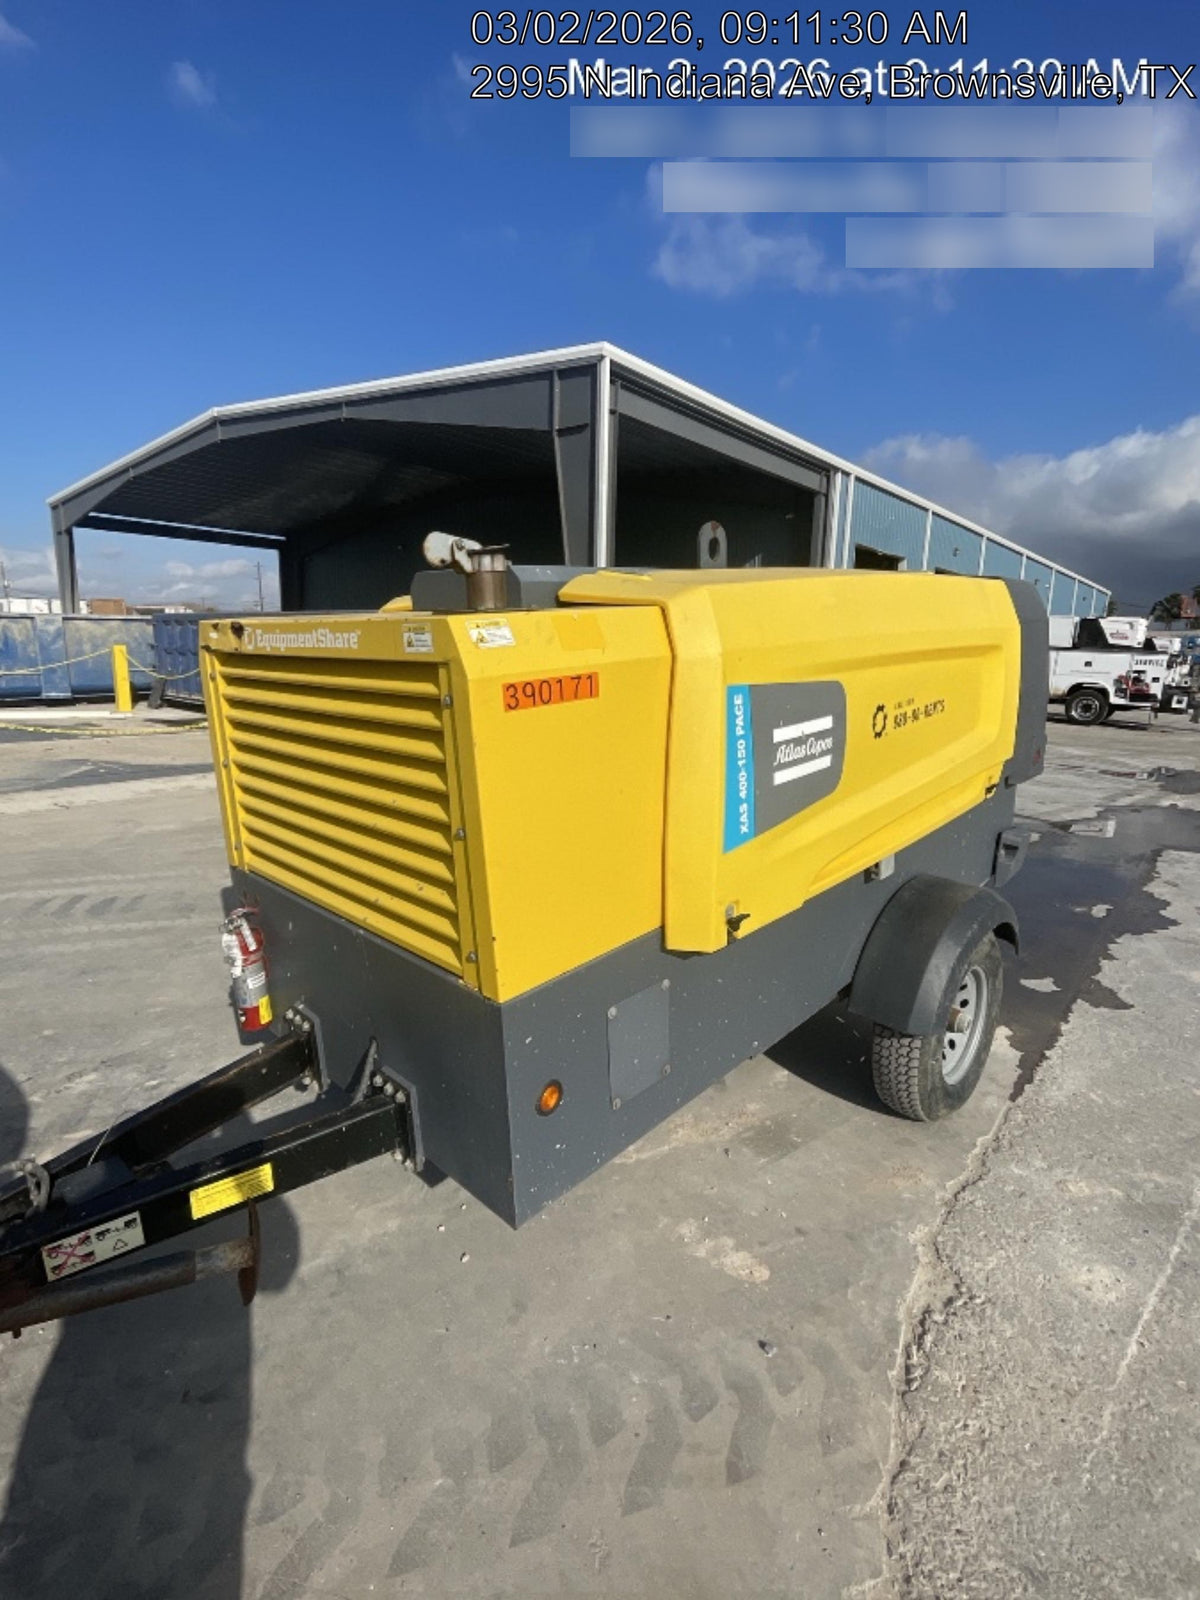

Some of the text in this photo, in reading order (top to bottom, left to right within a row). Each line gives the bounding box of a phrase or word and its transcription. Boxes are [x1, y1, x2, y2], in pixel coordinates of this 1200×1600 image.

[256, 628, 360, 652] EquipmentShare
[505, 674, 594, 710] 390171
[733, 694, 750, 835] XAS 400-150 PACE
[773, 743, 807, 767] Atlas
